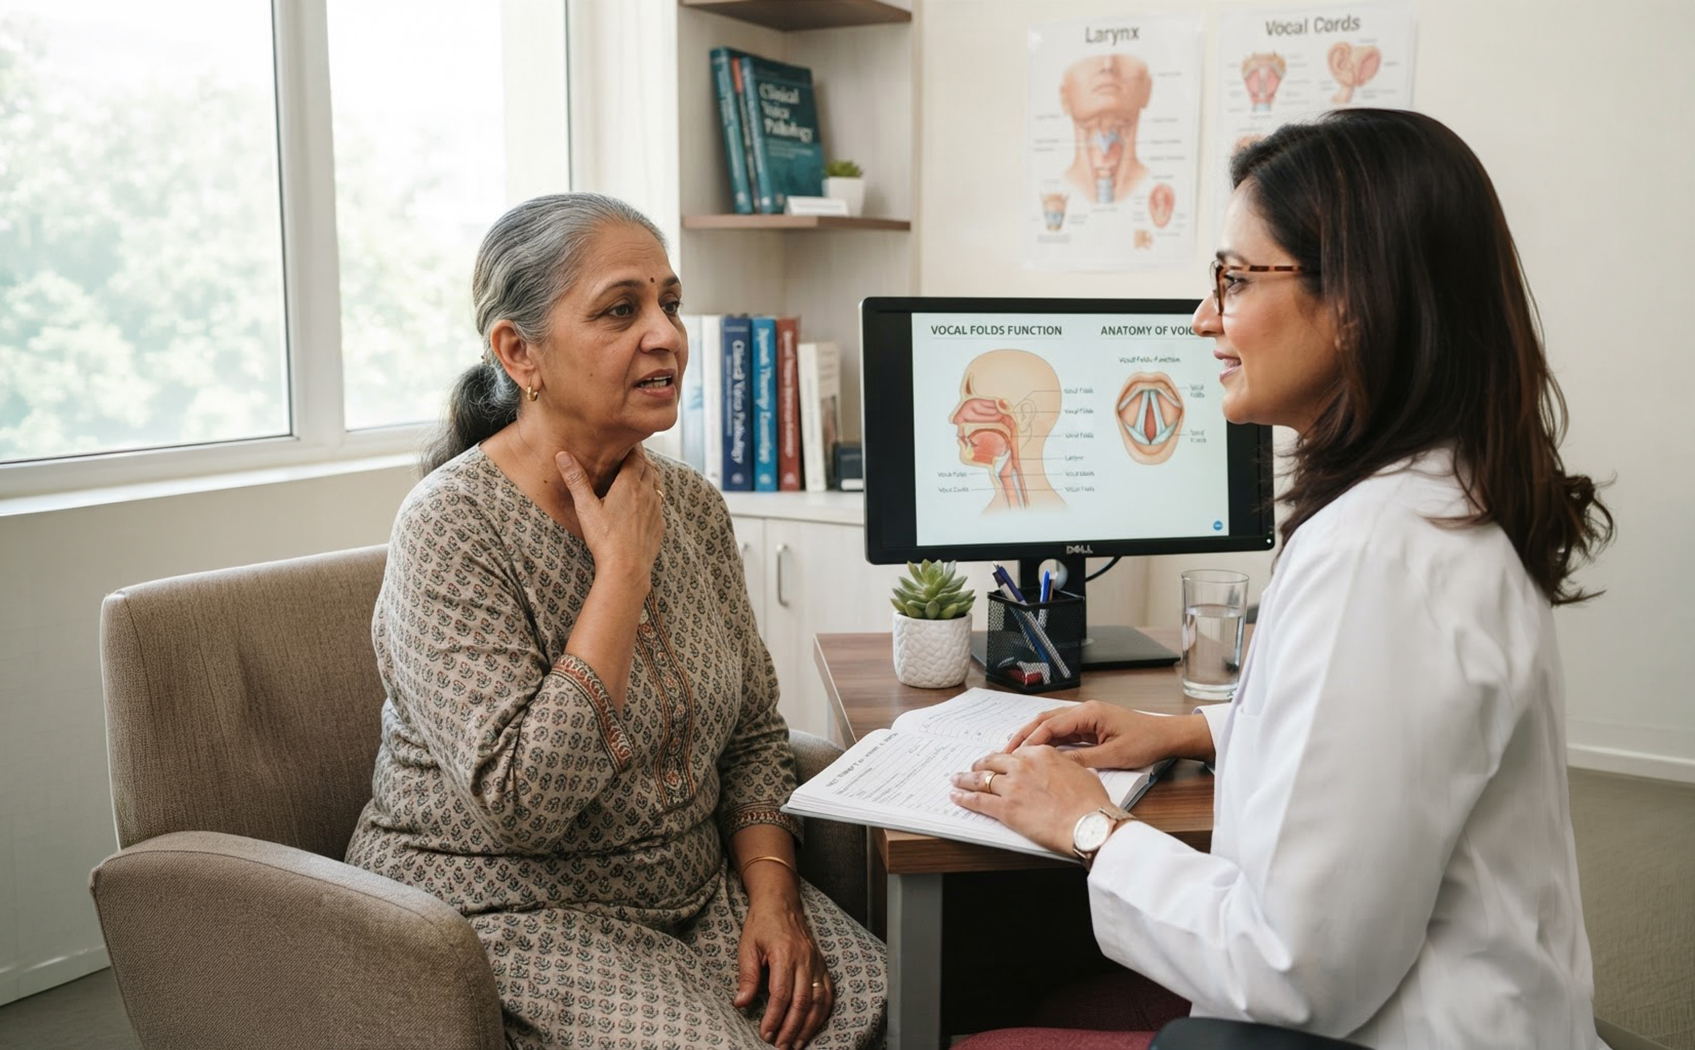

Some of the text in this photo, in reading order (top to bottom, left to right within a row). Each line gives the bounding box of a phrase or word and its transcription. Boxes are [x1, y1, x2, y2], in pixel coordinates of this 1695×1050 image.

[1266, 14, 1361, 36] Vocal Cords
[1085, 26, 1140, 46] Larynx
[931, 325, 1063, 336] VOCAL FOLDS FUNCTION
[1100, 326, 1194, 336] ANATOMY OF VOIC
[1066, 545, 1093, 555] DELL
